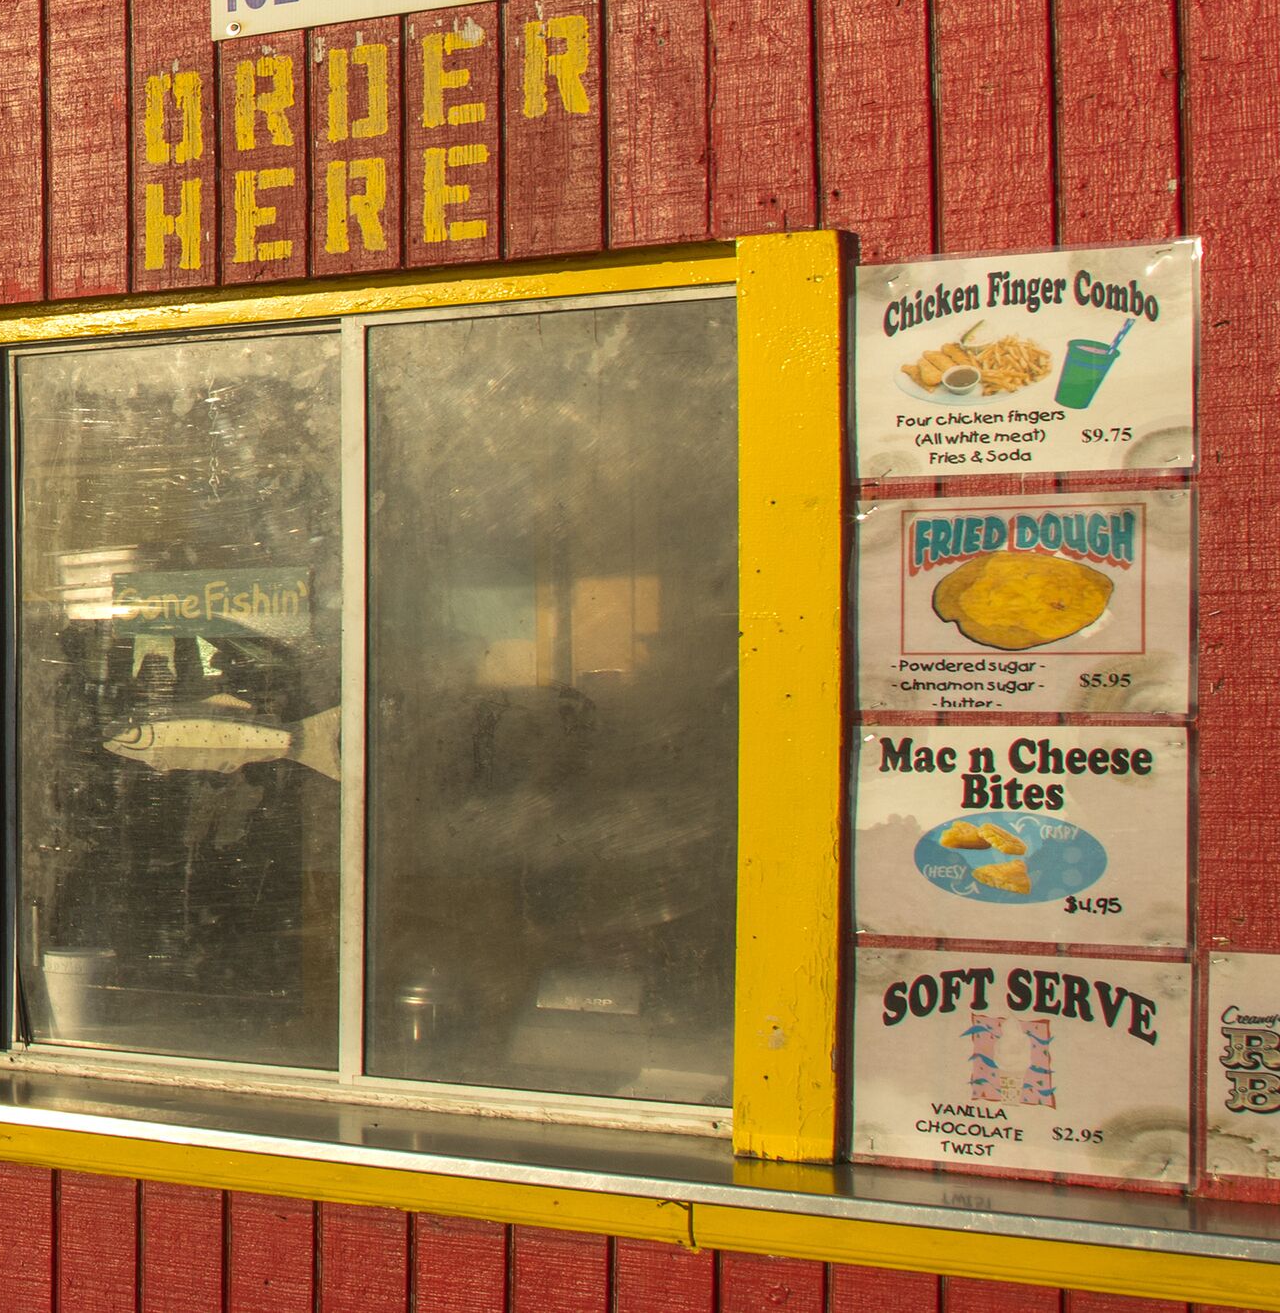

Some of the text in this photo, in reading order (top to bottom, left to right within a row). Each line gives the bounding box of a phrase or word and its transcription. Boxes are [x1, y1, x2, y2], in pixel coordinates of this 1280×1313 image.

[144, 13, 591, 165] ORDER
[144, 143, 488, 271] HERE
[882, 269, 1160, 338] Chicken Finger Combo
[896, 408, 1065, 428] Four chicken fingers
[915, 428, 1046, 447] (All white meat)
[1081, 426, 1133, 444] $9.75
[929, 448, 1032, 465] Fries & Soda
[910, 509, 1136, 572] FRIED DOUGH
[114, 580, 309, 621] Gone Fishin'
[988, 660, 1037, 674] sugar
[900, 679, 1036, 693] cinnamon sugar
[1079, 672, 1131, 688] $5.95
[878, 737, 1153, 776] Mac n Cheese
[960, 774, 1065, 811] Bites
[1040, 824, 1080, 840] CRISPY
[922, 863, 968, 880] CHEESY
[1064, 895, 1123, 915] $4.95
[882, 967, 1158, 1047] SOFT SERVE
[931, 1102, 1008, 1120] VANILLA
[915, 1119, 1024, 1142] CHOCOLATE
[1052, 1126, 1104, 1144] $2.95
[940, 1140, 995, 1157] TWIST
